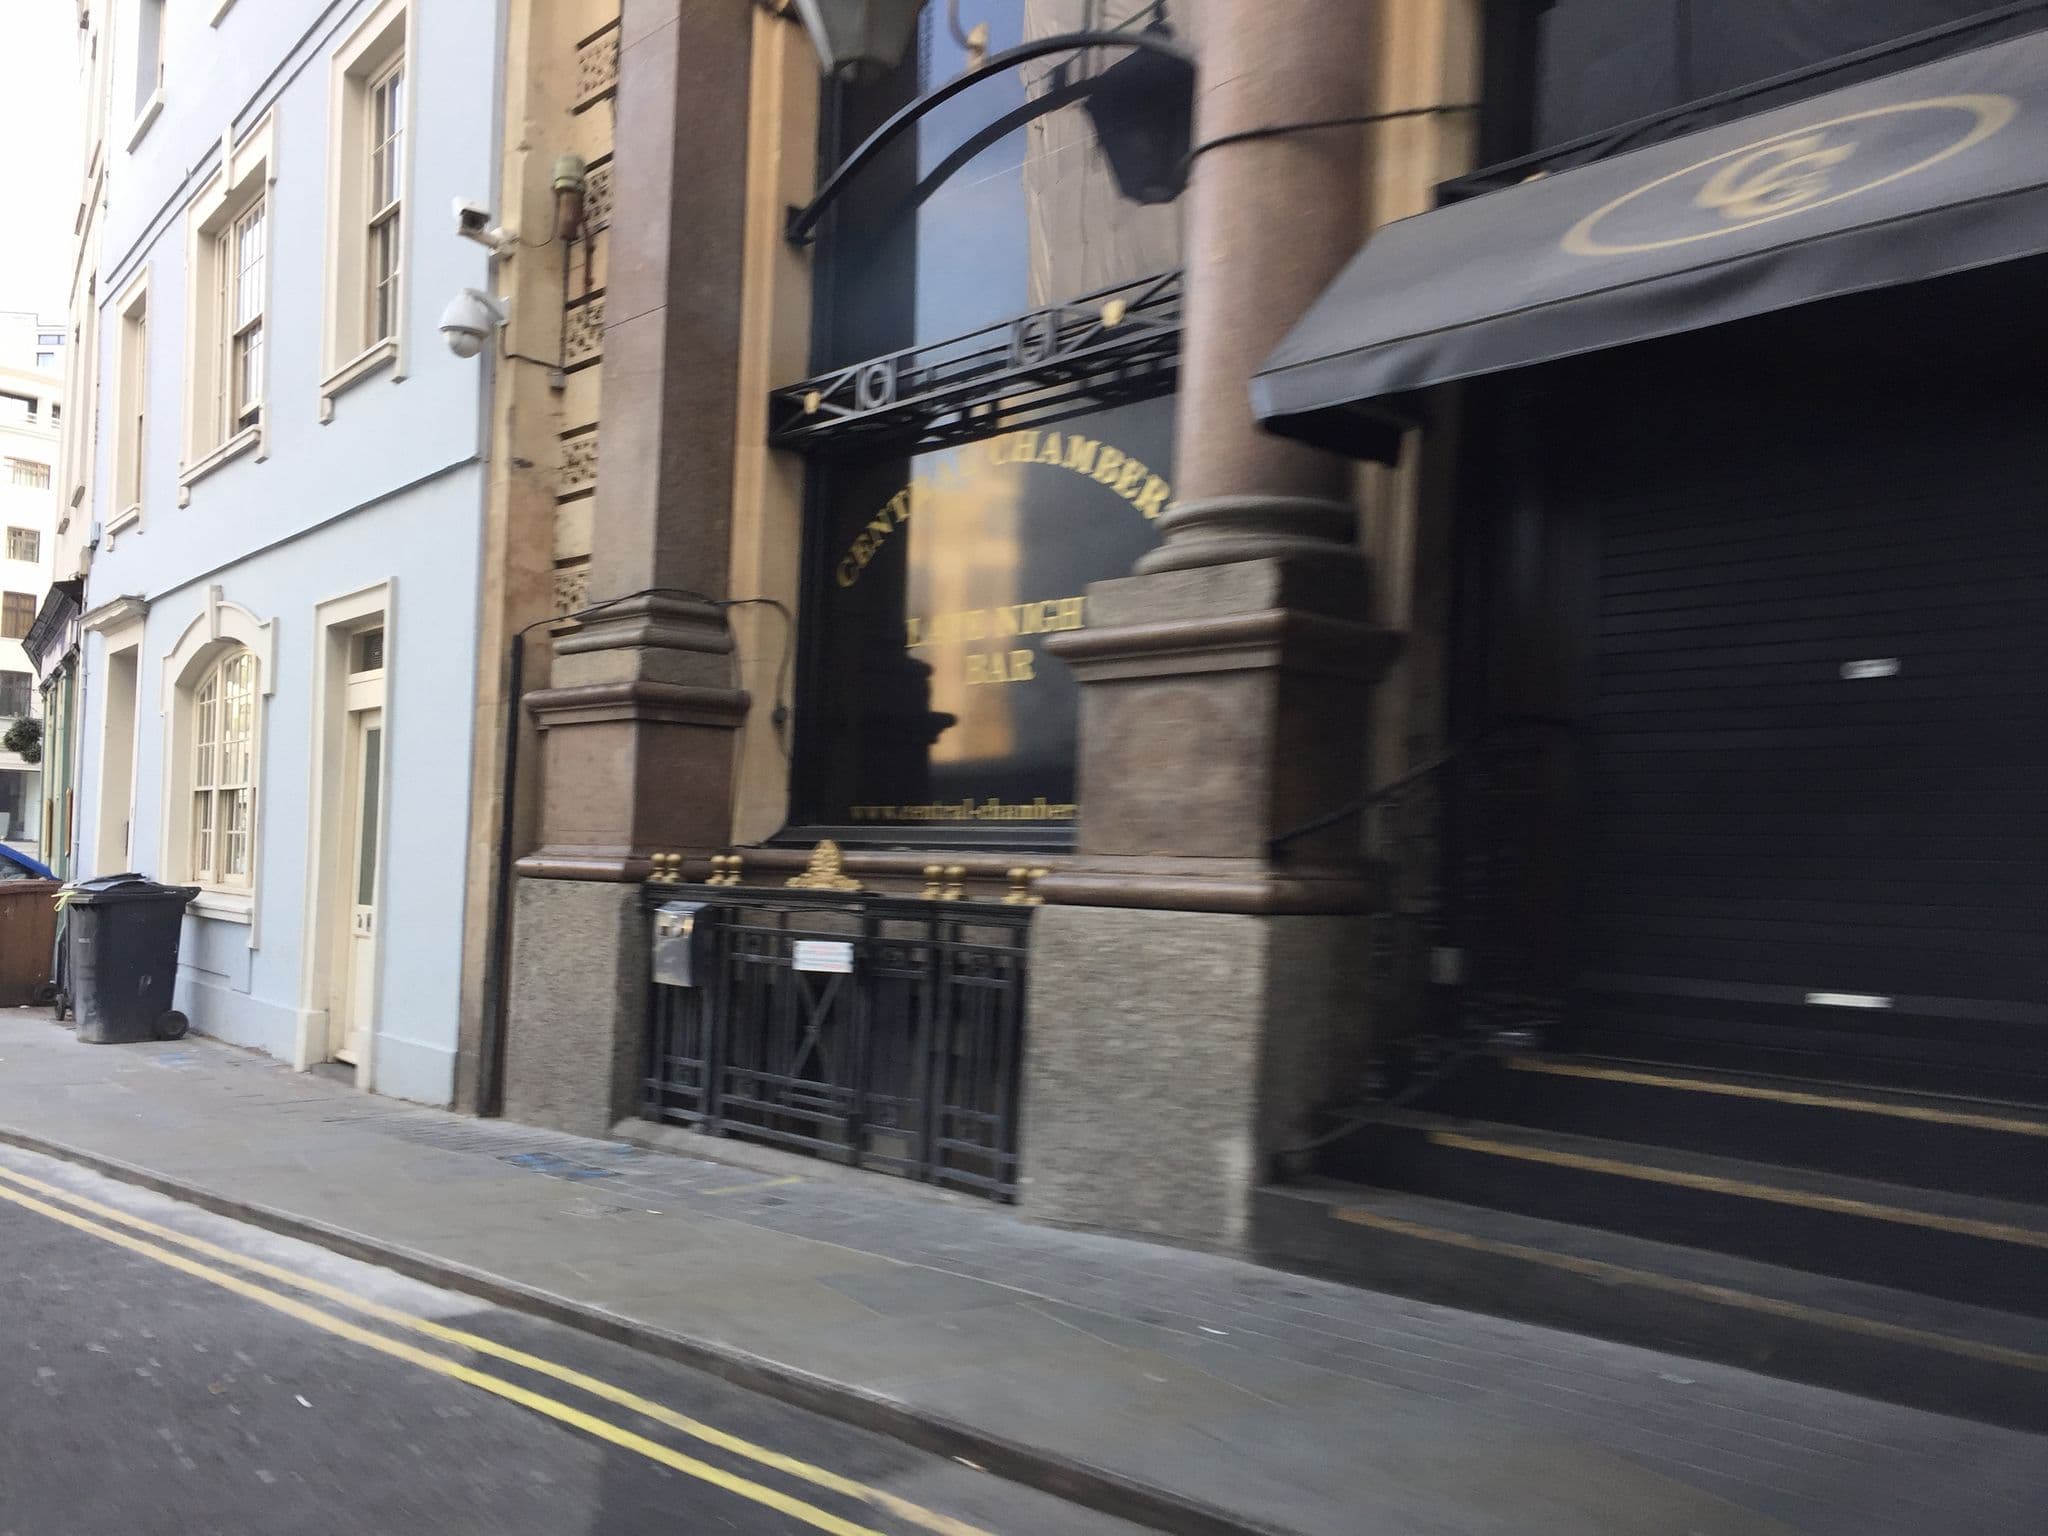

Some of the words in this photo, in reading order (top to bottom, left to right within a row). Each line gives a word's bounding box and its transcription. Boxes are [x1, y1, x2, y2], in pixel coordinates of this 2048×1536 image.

[988, 431, 1171, 519] CHAMBER
[996, 596, 1087, 637] NIGH
[965, 649, 1036, 685] BAR
